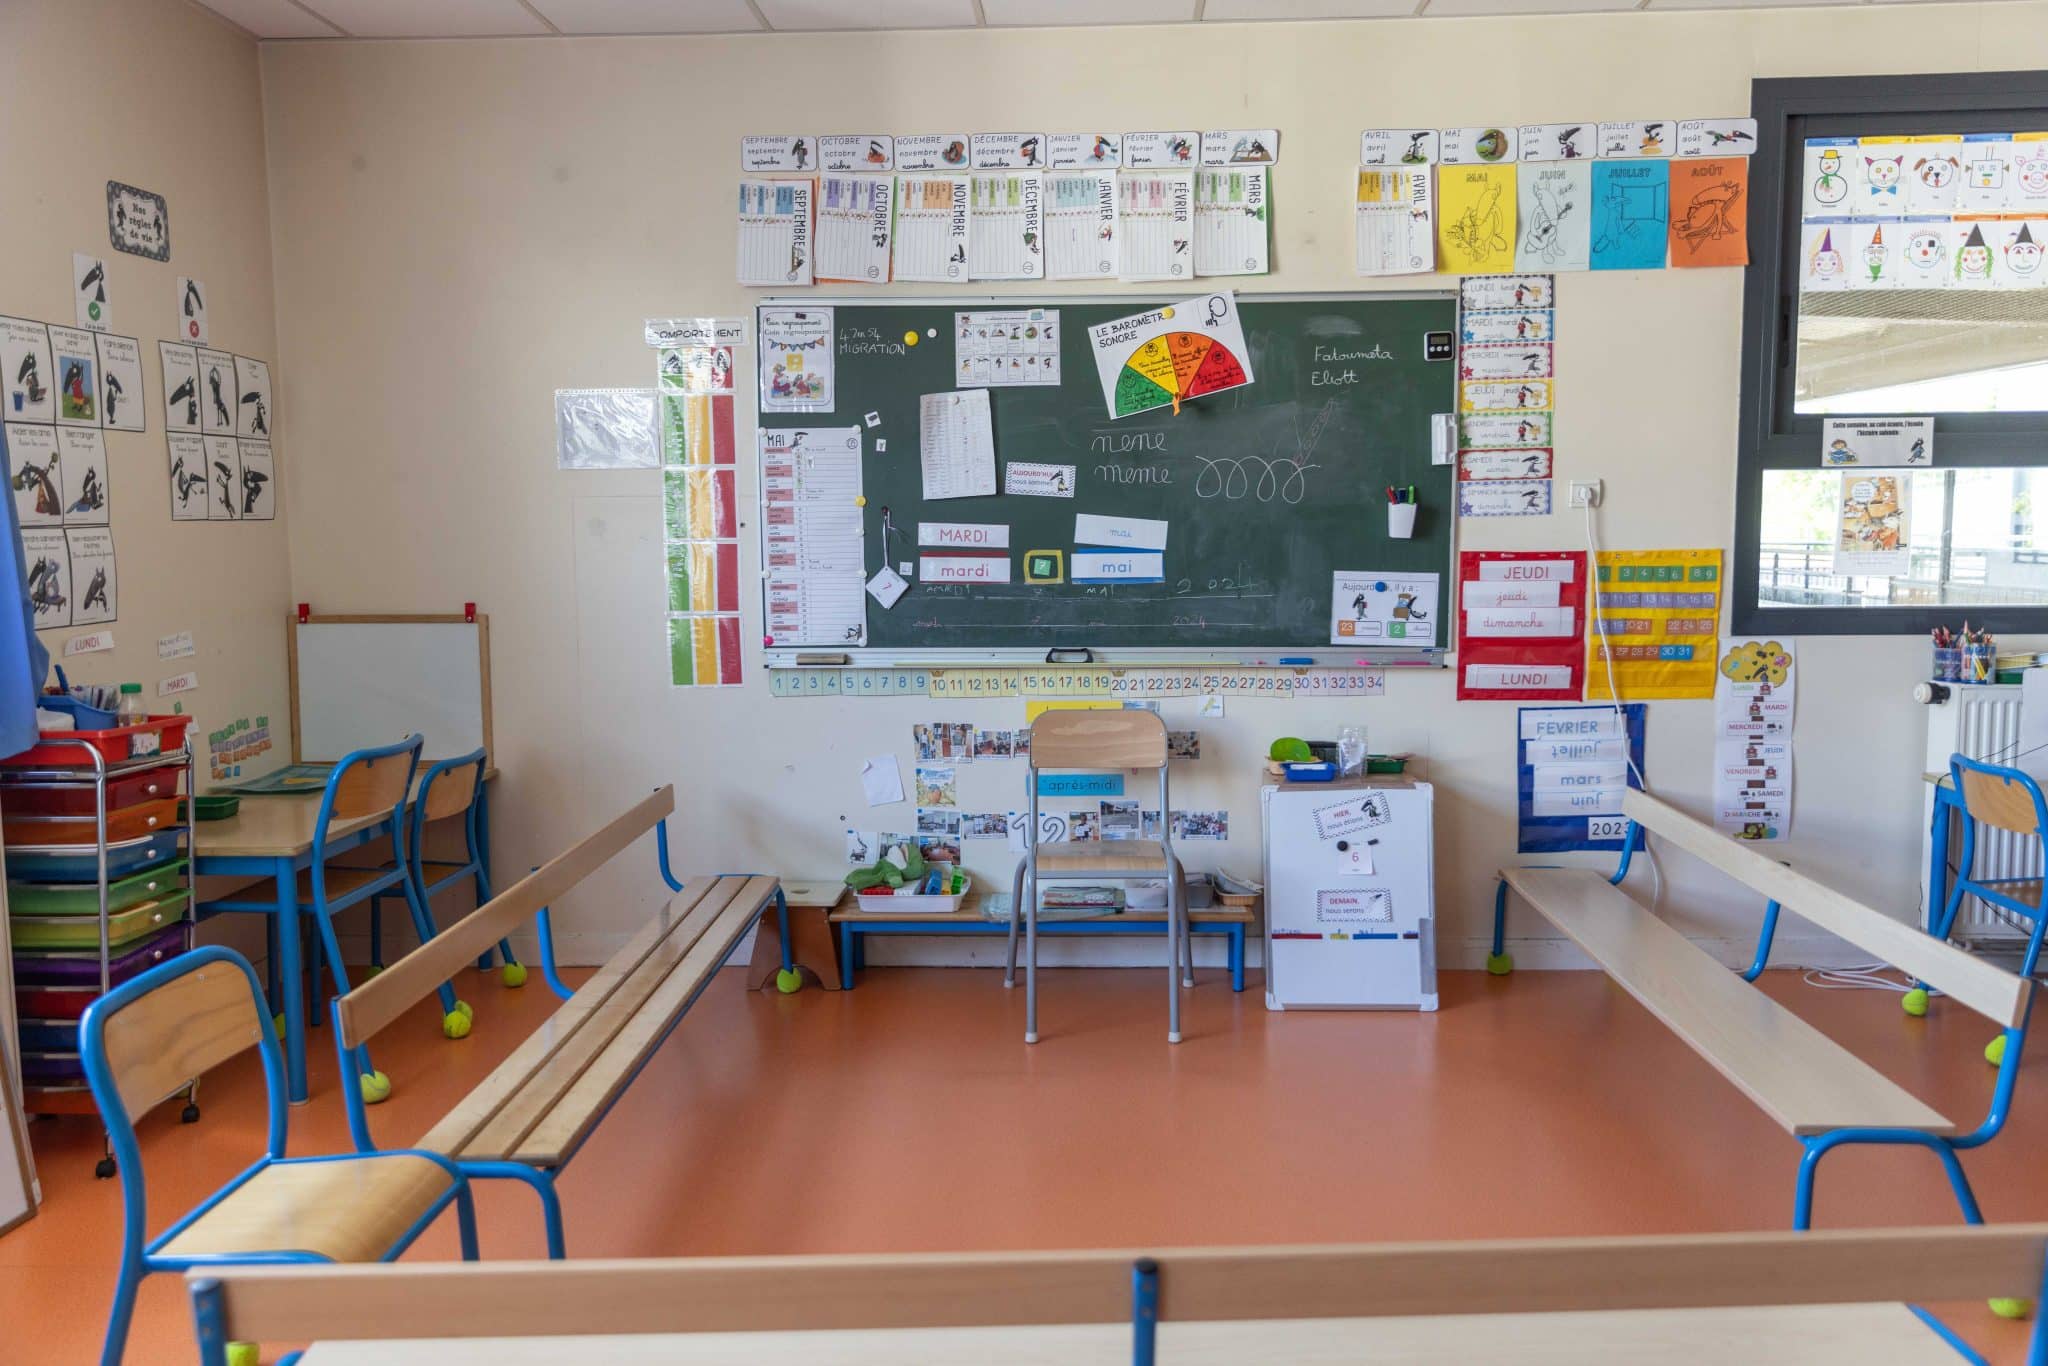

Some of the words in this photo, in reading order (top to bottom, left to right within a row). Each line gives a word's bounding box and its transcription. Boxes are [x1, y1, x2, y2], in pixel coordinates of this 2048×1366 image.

[1521, 126, 1542, 135] JUIN
[1602, 122, 1635, 130] JUILLET
[1681, 121, 1704, 130] AOÛT
[974, 134, 1019, 144] DÉCEMBRE
[1050, 135, 1081, 143] JANVIER
[1126, 133, 1159, 142] FÉVRIER
[1204, 132, 1227, 141] MARS
[1364, 131, 1391, 140] AVRIL
[1444, 129, 1462, 138] MAI
[745, 137, 788, 145] SEPTEMBRE
[822, 138, 861, 146] OCTOBRE
[897, 137, 941, 145] NOVEMBRE
[1366, 143, 1386, 152] avril
[1444, 142, 1459, 150] mai
[1524, 138, 1540, 147] juin
[747, 148, 785, 156] septembre
[824, 149, 856, 158] octobre
[899, 148, 938, 158] novembre
[976, 147, 1015, 157] décembre
[1051, 145, 1078, 154] janvier
[1205, 145, 1227, 153] mars
[1539, 170, 1566, 181] JUIN
[1608, 167, 1652, 178] JUILLET
[1690, 164, 1724, 177] AOÛT
[1465, 172, 1489, 183] MAI
[1247, 173, 1262, 205] MARS
[1412, 173, 1426, 206] AVRIL
[1023, 178, 1038, 233] DÉCEMBRE
[1098, 178, 1113, 222] JANVIER
[1174, 181, 1190, 223] FÉVRIER
[132, 202, 147, 215] Nos
[874, 183, 889, 238] OCTOBRE
[952, 183, 966, 237] NOVEMBRE
[128, 215, 152, 230] règles
[793, 189, 807, 247] SEPTEMBRE
[129, 230, 139, 240] de
[141, 232, 153, 243] vie
[1095, 326, 1109, 338] LE
[1111, 311, 1166, 334] BAROMÈTR
[1099, 330, 1138, 349] SONORE
[1314, 344, 1393, 362] Fatoumata
[767, 434, 785, 447] MAI
[939, 528, 988, 544] MARDI
[1109, 527, 1133, 538] mai
[940, 563, 990, 578] mardi
[1102, 559, 1133, 574] mai
[1503, 566, 1550, 580] JEUDI
[1496, 591, 1529, 604] jeudi
[1482, 611, 1545, 628] dimanche
[74, 637, 101, 651] LUNDI
[1661, 647, 1675, 656] 30
[1677, 647, 1691, 656] 31
[167, 677, 188, 690] MARDI
[776, 678, 781, 689] 1
[792, 677, 800, 689] 2
[810, 677, 818, 689] 3
[827, 676, 836, 688] 4
[846, 677, 854, 689] 5
[863, 676, 871, 688] 6
[881, 676, 889, 688] 7
[899, 676, 907, 688] 8
[916, 675, 925, 688] 9
[932, 679, 946, 691] 10
[950, 679, 963, 691] 11
[968, 679, 981, 690] 12
[986, 678, 999, 690] 13
[1003, 678, 1016, 690] 14
[1024, 676, 1037, 688] 15
[1042, 676, 1055, 688] 16
[1059, 676, 1072, 688] 17
[1077, 676, 1091, 688] 18
[1095, 676, 1109, 688] 19
[1112, 679, 1127, 691] 20
[1130, 679, 1143, 690] 21
[1148, 678, 1163, 690] 22
[1166, 678, 1181, 690] 23
[1184, 677, 1199, 689] 24
[1204, 676, 1219, 688] 25
[1222, 676, 1237, 688] 26
[1240, 677, 1255, 689] 27
[1258, 678, 1274, 690] 28
[1276, 678, 1292, 690] 29
[1294, 677, 1309, 689] 30
[1313, 677, 1327, 689] 31
[1331, 677, 1346, 689] 32
[1349, 676, 1364, 689] 33
[1367, 676, 1382, 688] 34
[1500, 672, 1548, 686] LUNDI
[1551, 740, 1601, 759] juillet
[1047, 777, 1117, 793] après-midi
[1560, 775, 1602, 786] mars
[1571, 792, 1604, 808] juin
[1351, 851, 1360, 863] 6
